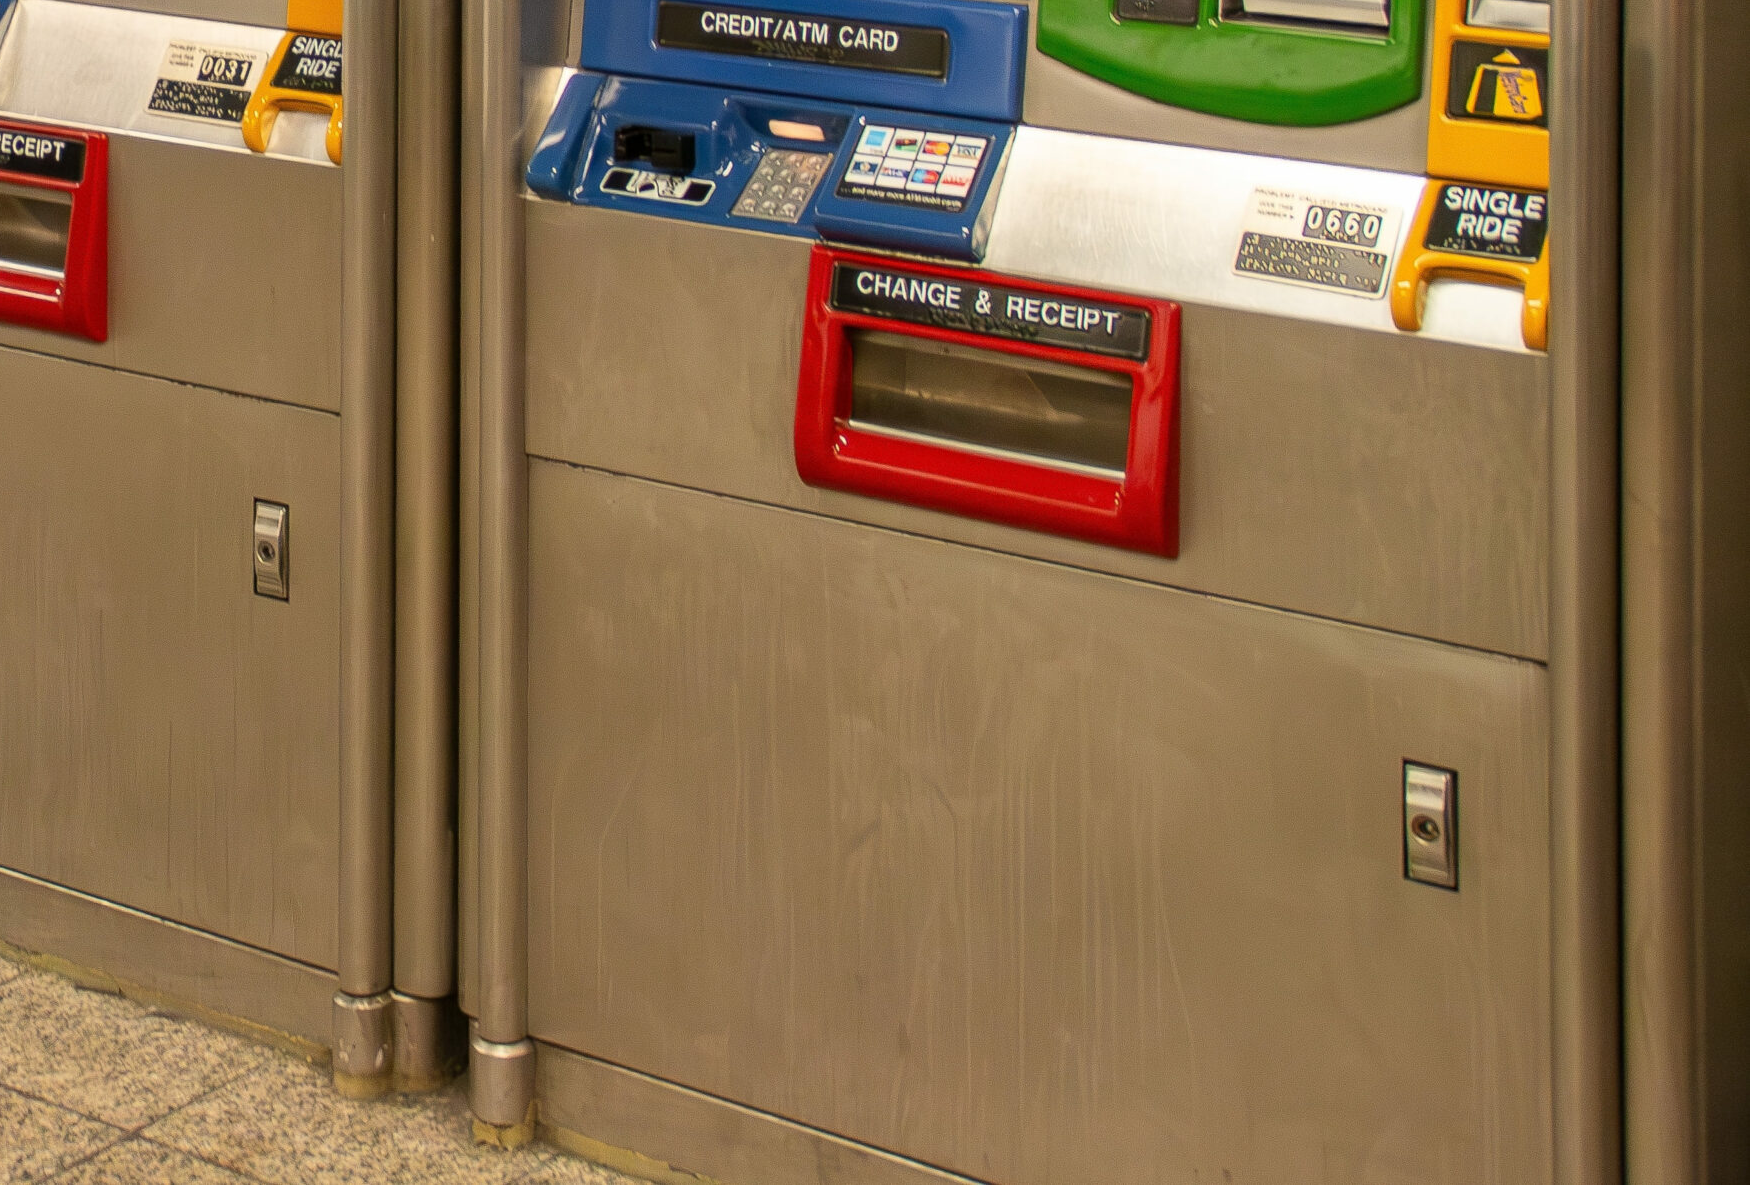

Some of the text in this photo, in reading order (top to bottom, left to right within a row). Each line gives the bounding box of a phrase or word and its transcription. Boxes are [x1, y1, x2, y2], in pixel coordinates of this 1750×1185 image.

[700, 10, 900, 52] CREDIT/ATM CARD
[292, 36, 342, 58] SINGL
[201, 56, 249, 81] 0031
[296, 57, 340, 78] RIDE
[1444, 186, 1546, 220] SINGLE
[1307, 206, 1380, 239] 0660
[1456, 215, 1522, 243] RIDE
[856, 270, 1120, 335] CHANGE & RECEIPT
